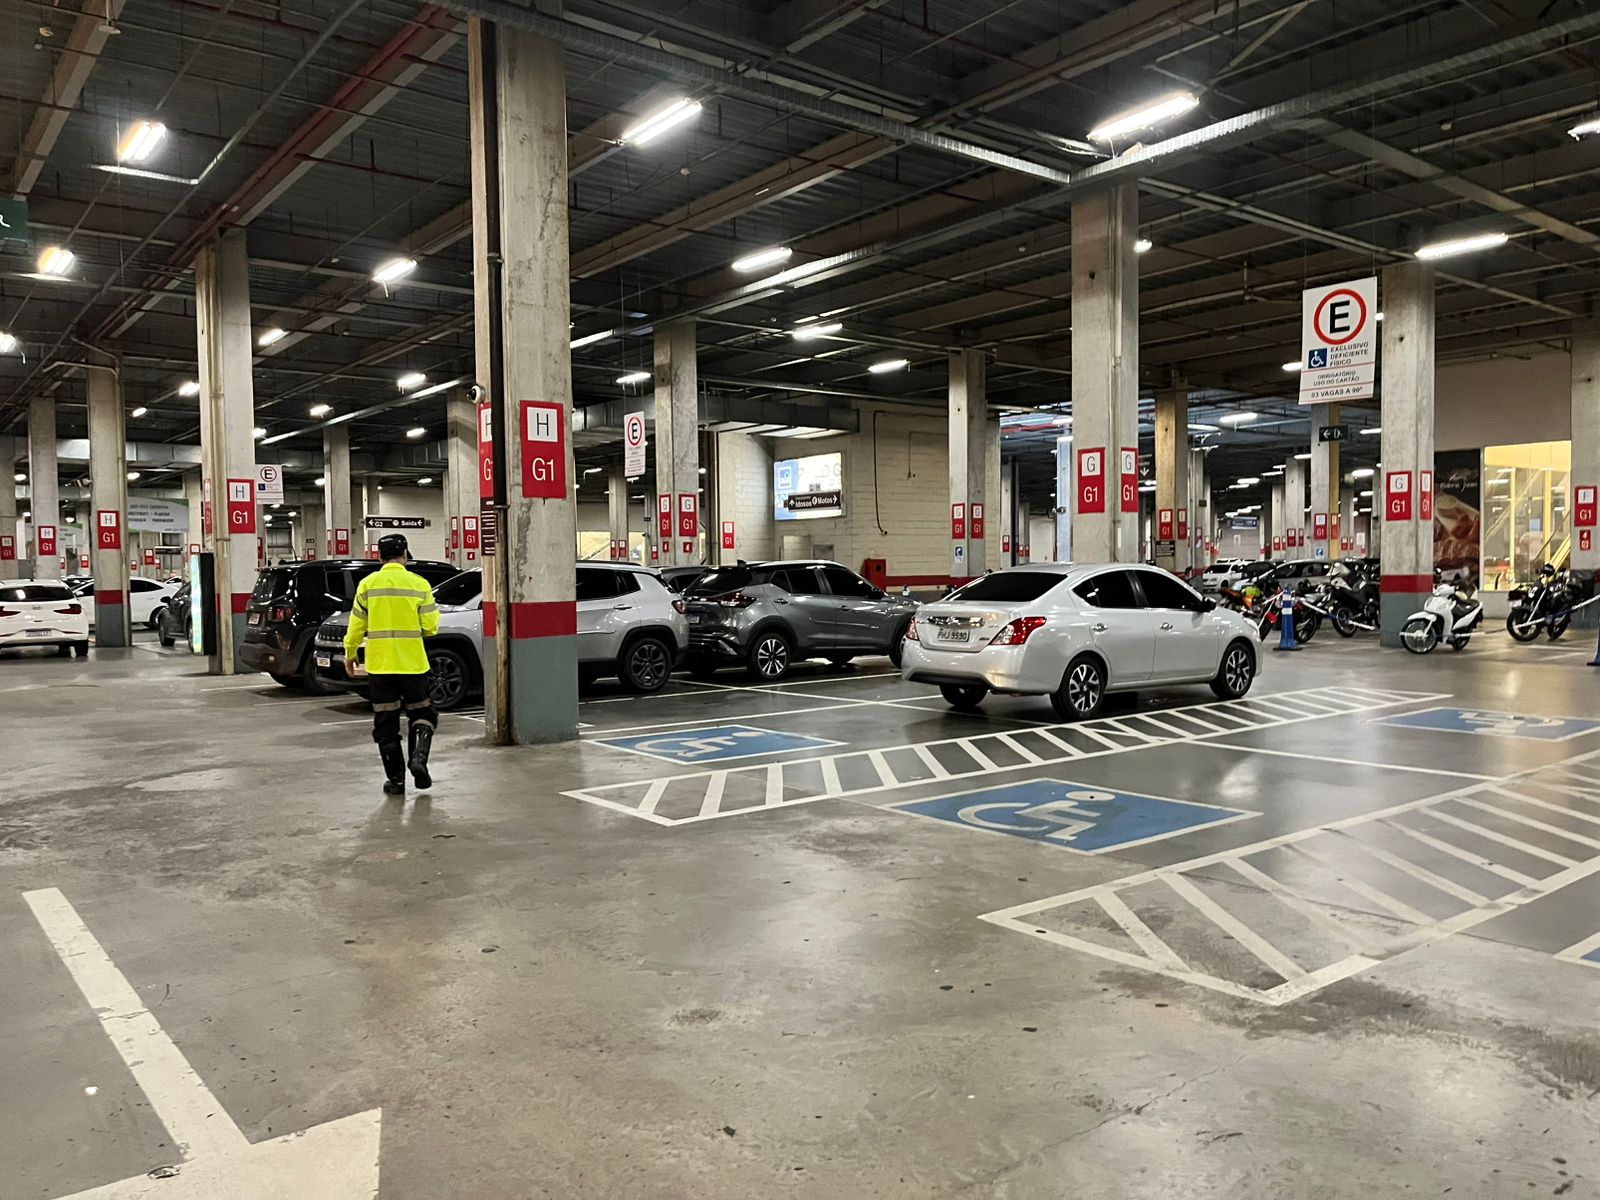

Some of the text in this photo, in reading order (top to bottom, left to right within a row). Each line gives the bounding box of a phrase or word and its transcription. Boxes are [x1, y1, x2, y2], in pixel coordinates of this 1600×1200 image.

[1330, 300, 1350, 334] E
[1330, 341, 1368, 352] EXCLUSIVO
[1330, 349, 1368, 360] DEFICIENTE
[1330, 358, 1351, 367] FÍSICO
[1320, 389, 1344, 397] VAGAS
[537, 413, 549, 437] H
[631, 422, 638, 439] E
[1087, 456, 1096, 473] G
[1125, 454, 1132, 471] G
[264, 469, 272, 480] E
[484, 457, 493, 481] G
[532, 457, 555, 481] G1
[1395, 477, 1403, 490] G
[235, 485, 244, 499] H
[1084, 486, 1098, 503] G1
[1122, 484, 1134, 501] G1
[684, 499, 691, 510] G
[795, 500, 812, 508] Idosos
[1391, 499, 1406, 513] G1
[104, 515, 112, 524] H
[232, 510, 248, 524] G1
[468, 520, 474, 528] G
[662, 518, 669, 529] G1
[682, 518, 693, 529] G1
[954, 524, 962, 534] G1
[974, 524, 981, 533] G1
[44, 529, 51, 537] H
[103, 533, 115, 543] G1
[466, 535, 476, 543] G1
[42, 543, 52, 551] G1
